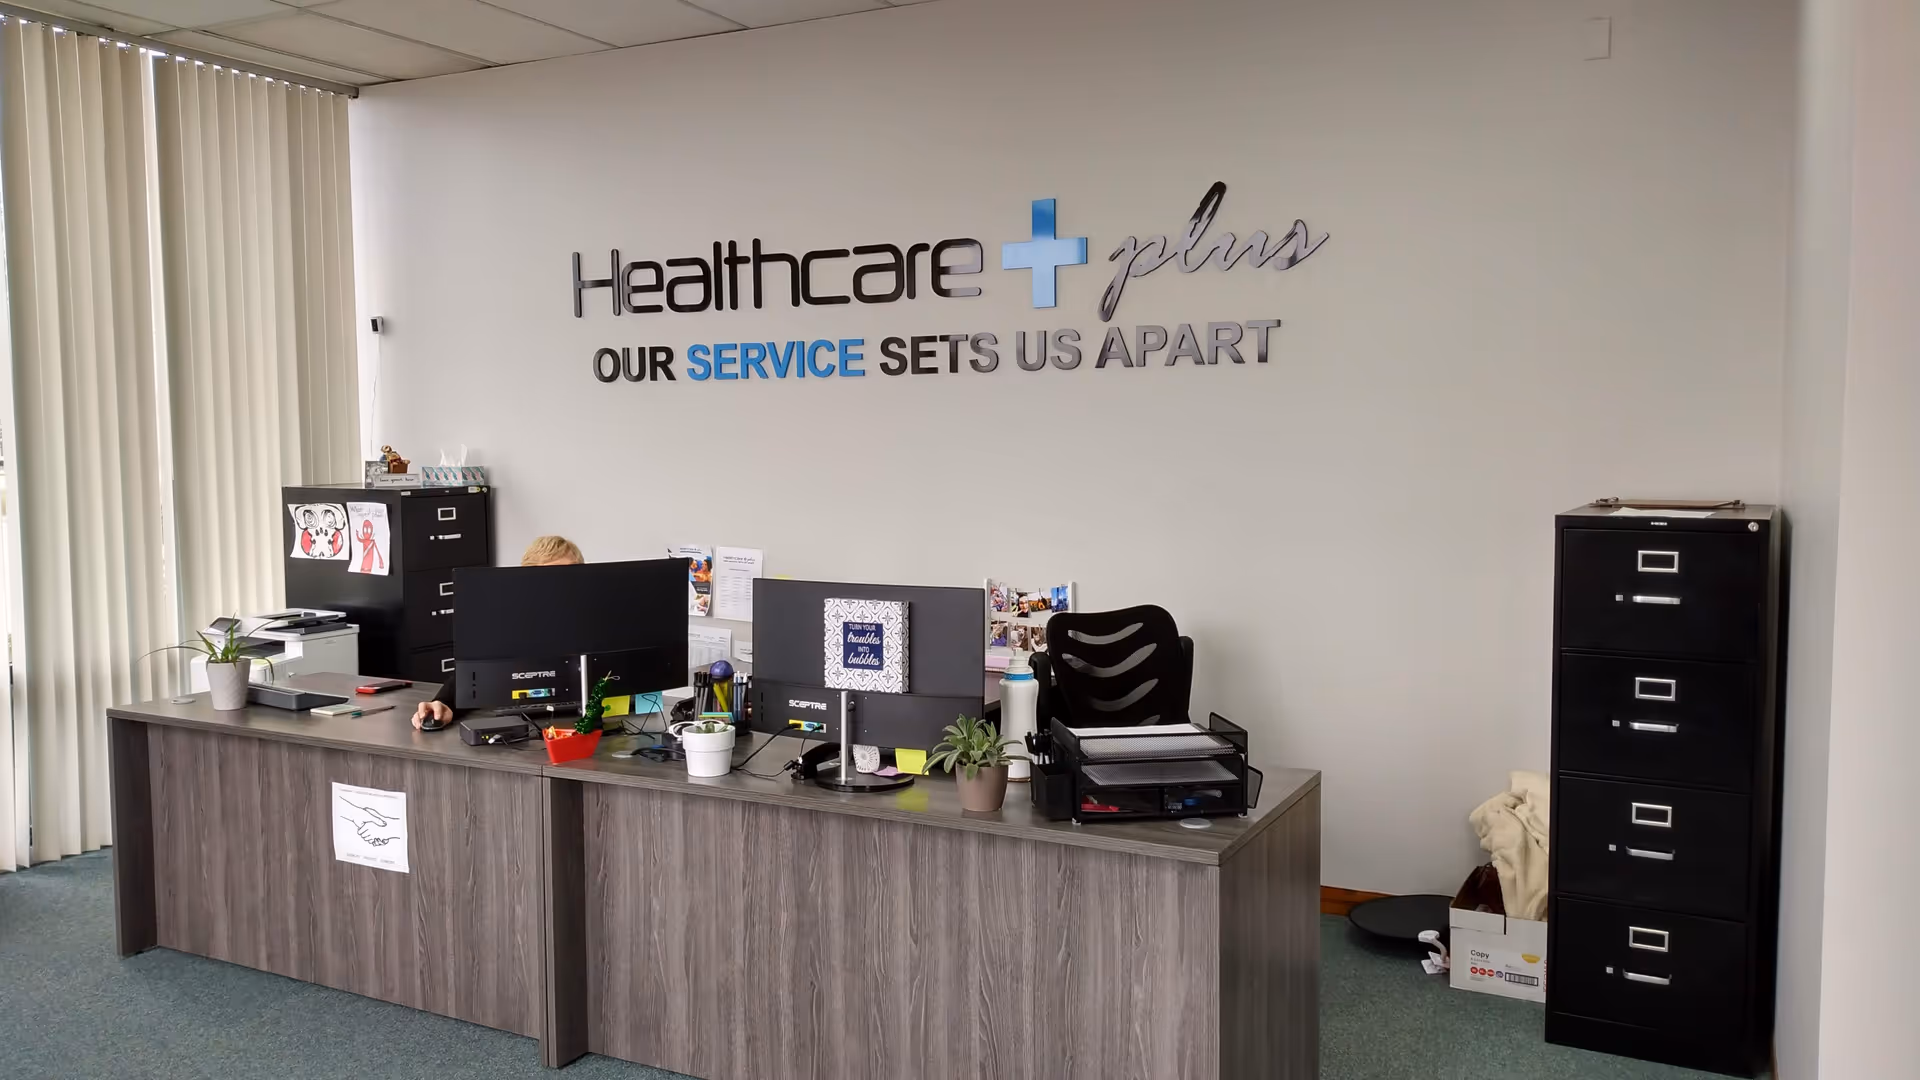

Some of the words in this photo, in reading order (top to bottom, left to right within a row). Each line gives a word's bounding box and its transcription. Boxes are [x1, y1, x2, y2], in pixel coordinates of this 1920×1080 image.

[572, 238, 983, 318] Healthcare
[1099, 181, 1329, 322] plus
[593, 346, 677, 383] OUR
[686, 338, 865, 381] SERVICE
[879, 332, 999, 376] SETS
[1016, 329, 1082, 371] US
[1095, 319, 1281, 368] APART
[847, 631, 881, 644] troubles
[848, 652, 880, 665] bubbles
[512, 671, 555, 679] SCEPTRE
[789, 700, 827, 710] SCEPTRE
[1471, 950, 1489, 959] Copy
